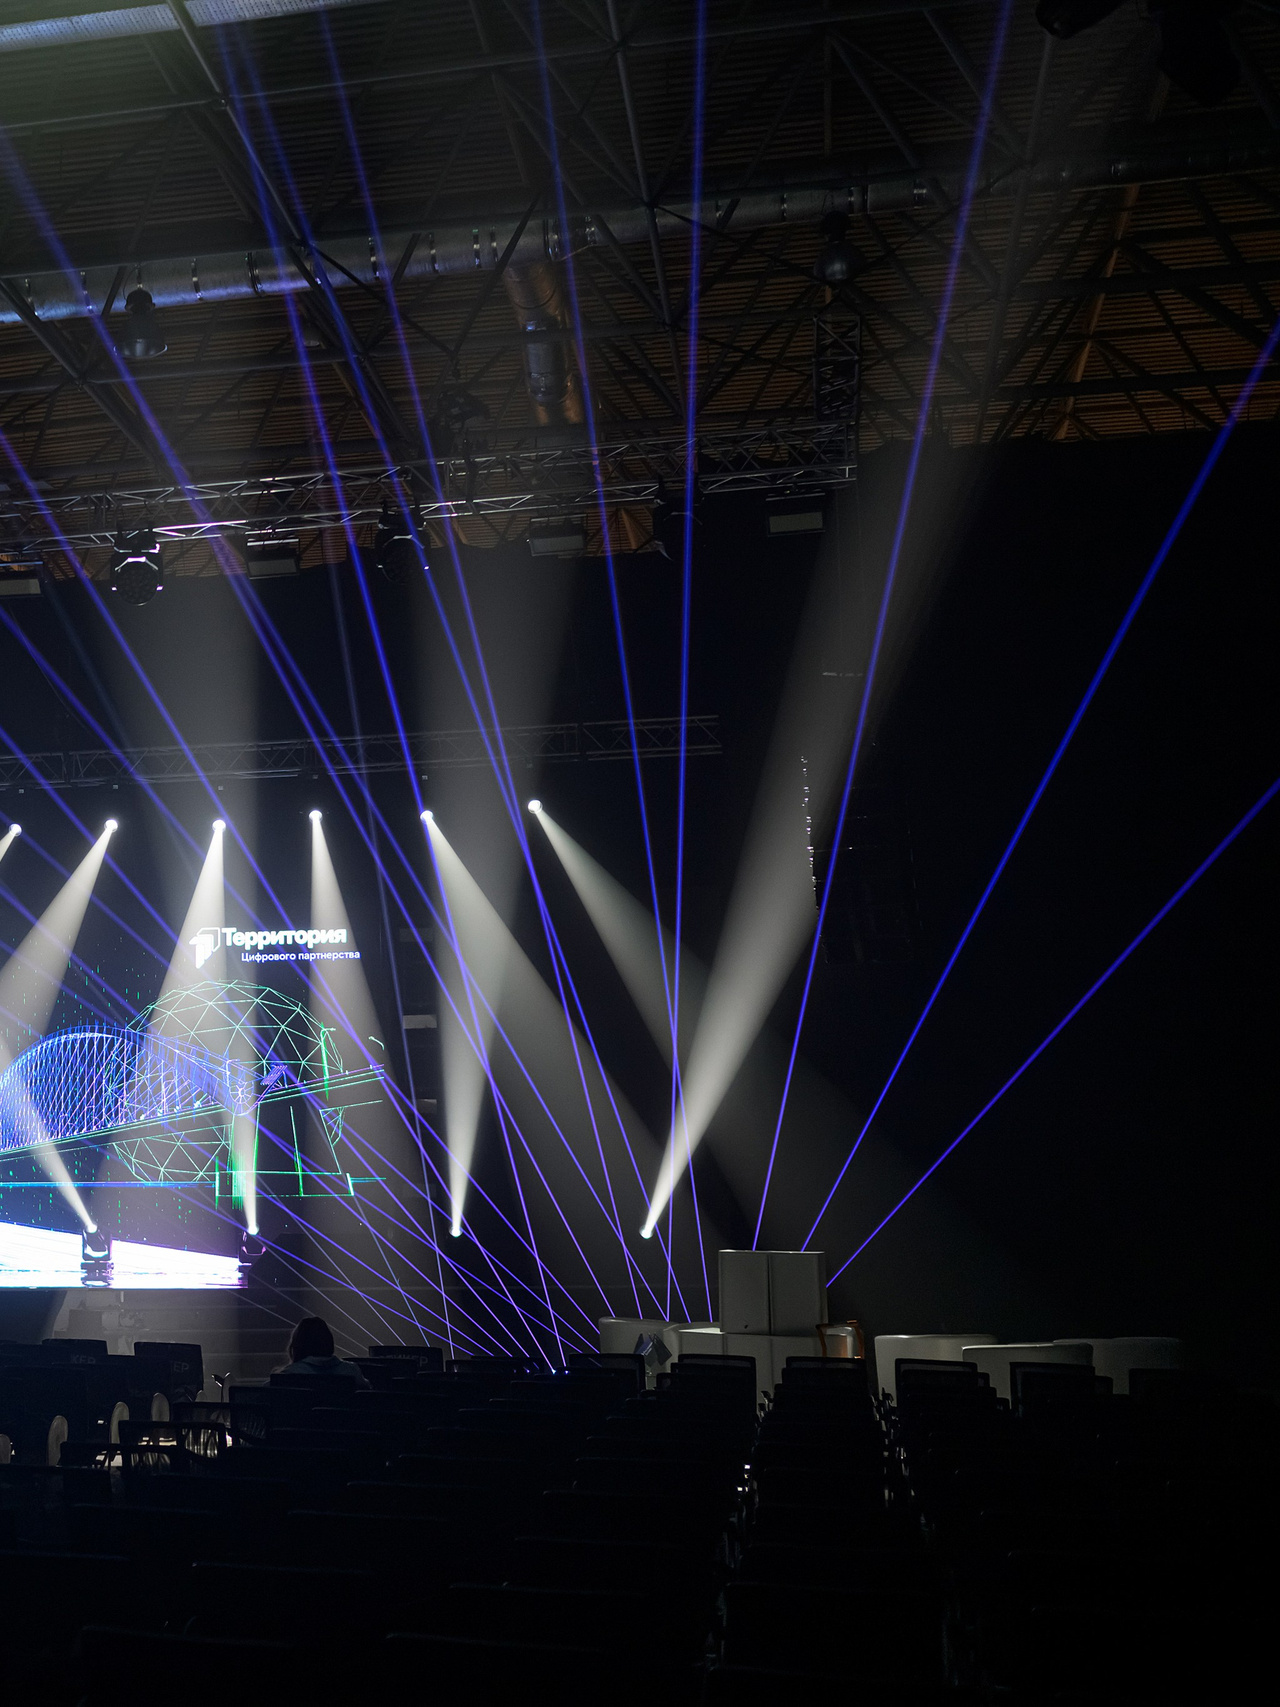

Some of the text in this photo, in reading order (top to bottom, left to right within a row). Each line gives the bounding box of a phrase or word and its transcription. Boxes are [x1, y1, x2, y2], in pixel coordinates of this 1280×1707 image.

[222, 928, 346, 949] Территория
[241, 951, 361, 962] Цифрового партнерства
